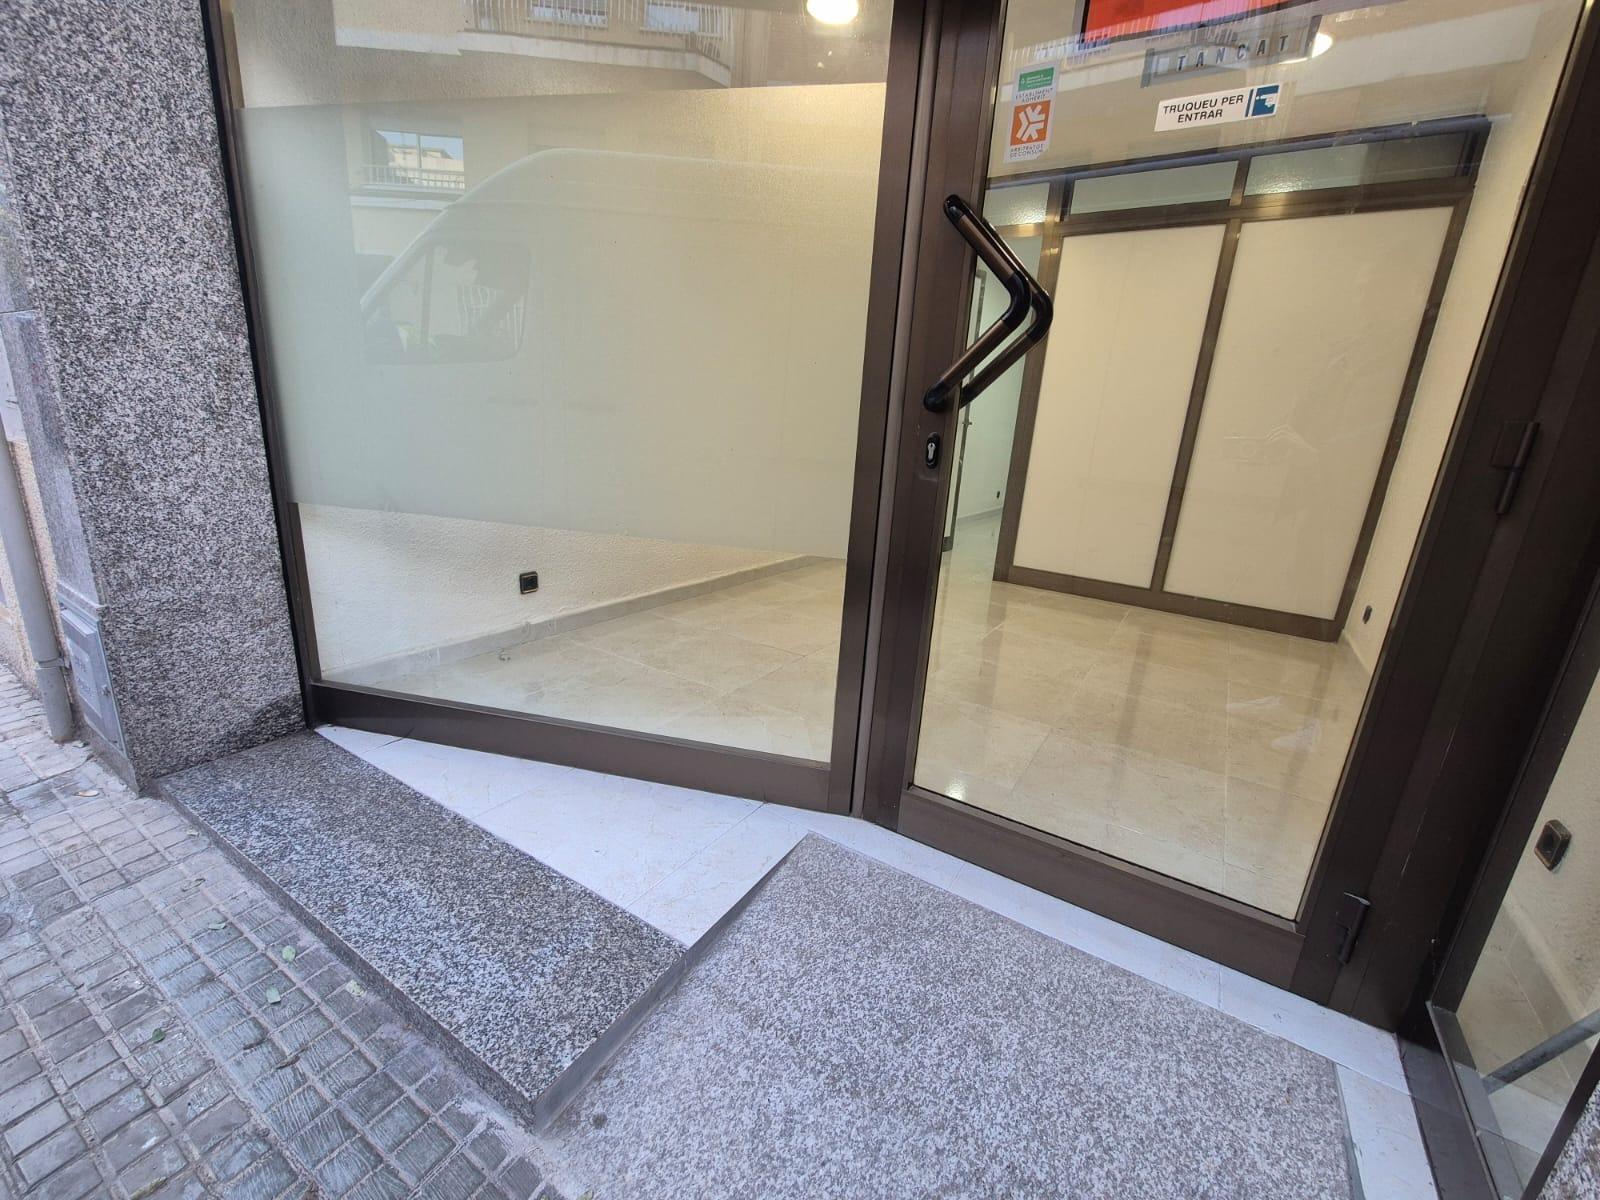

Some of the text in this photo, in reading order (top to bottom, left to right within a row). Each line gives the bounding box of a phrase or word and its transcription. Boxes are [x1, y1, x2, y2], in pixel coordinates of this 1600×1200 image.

[1177, 35, 1289, 71] TANCAT
[1163, 94, 1244, 114] TRUQUEU PER
[1177, 109, 1223, 123] ENTRAR
